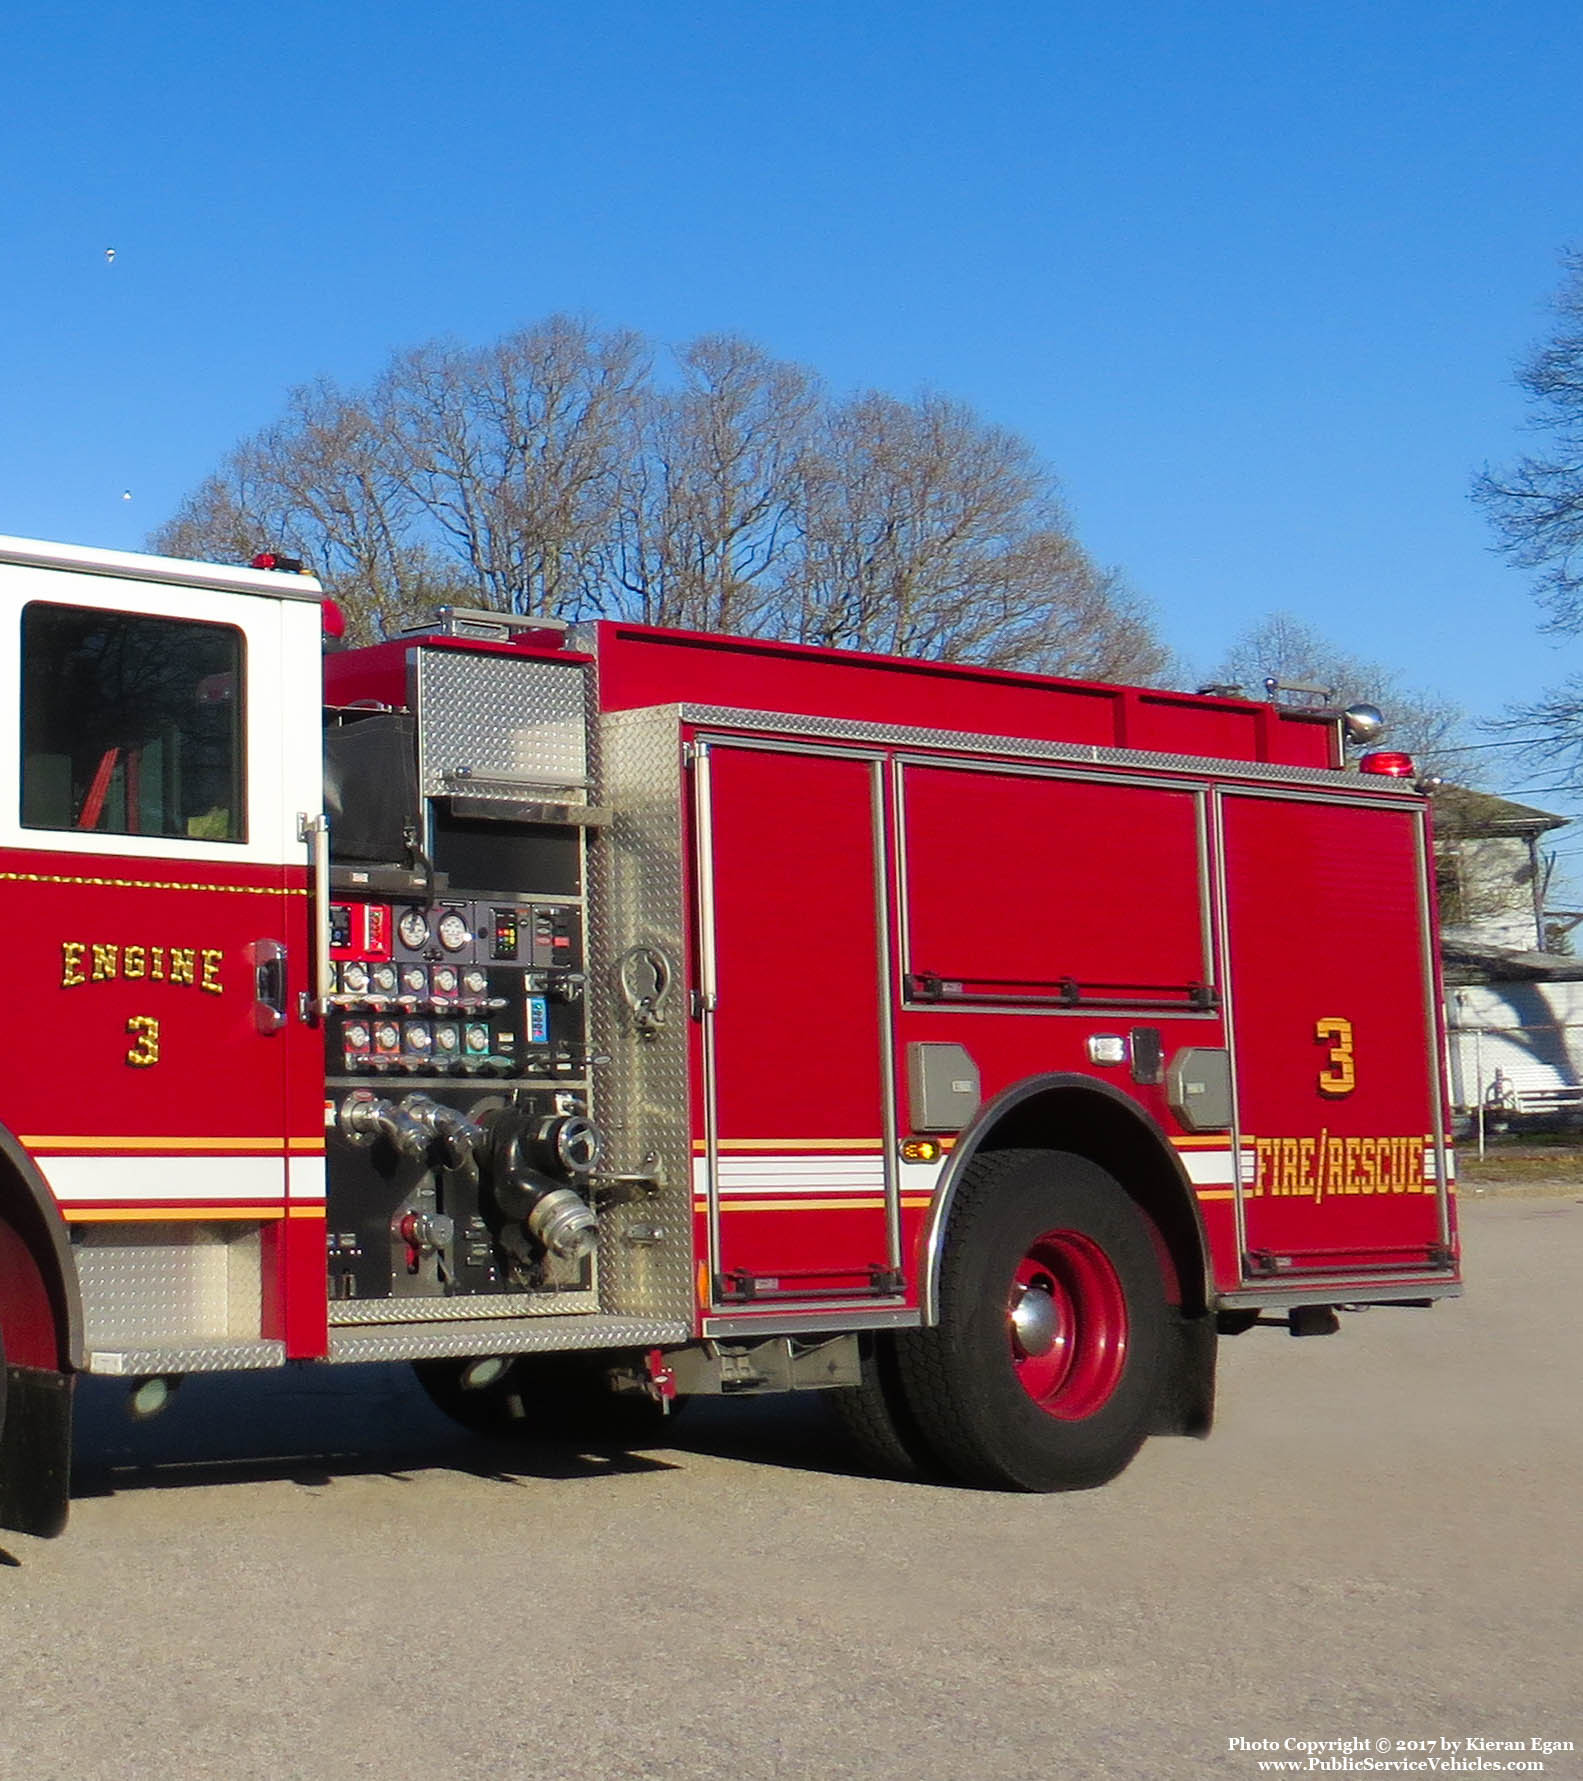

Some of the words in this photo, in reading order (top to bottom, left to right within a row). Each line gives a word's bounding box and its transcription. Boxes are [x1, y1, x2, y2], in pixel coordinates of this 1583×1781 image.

[61, 941, 224, 994] ENGINE
[126, 1015, 160, 1067] 3
[1315, 1017, 1356, 1099] 3
[1255, 1128, 1423, 1204] FIRE/RESCUE
